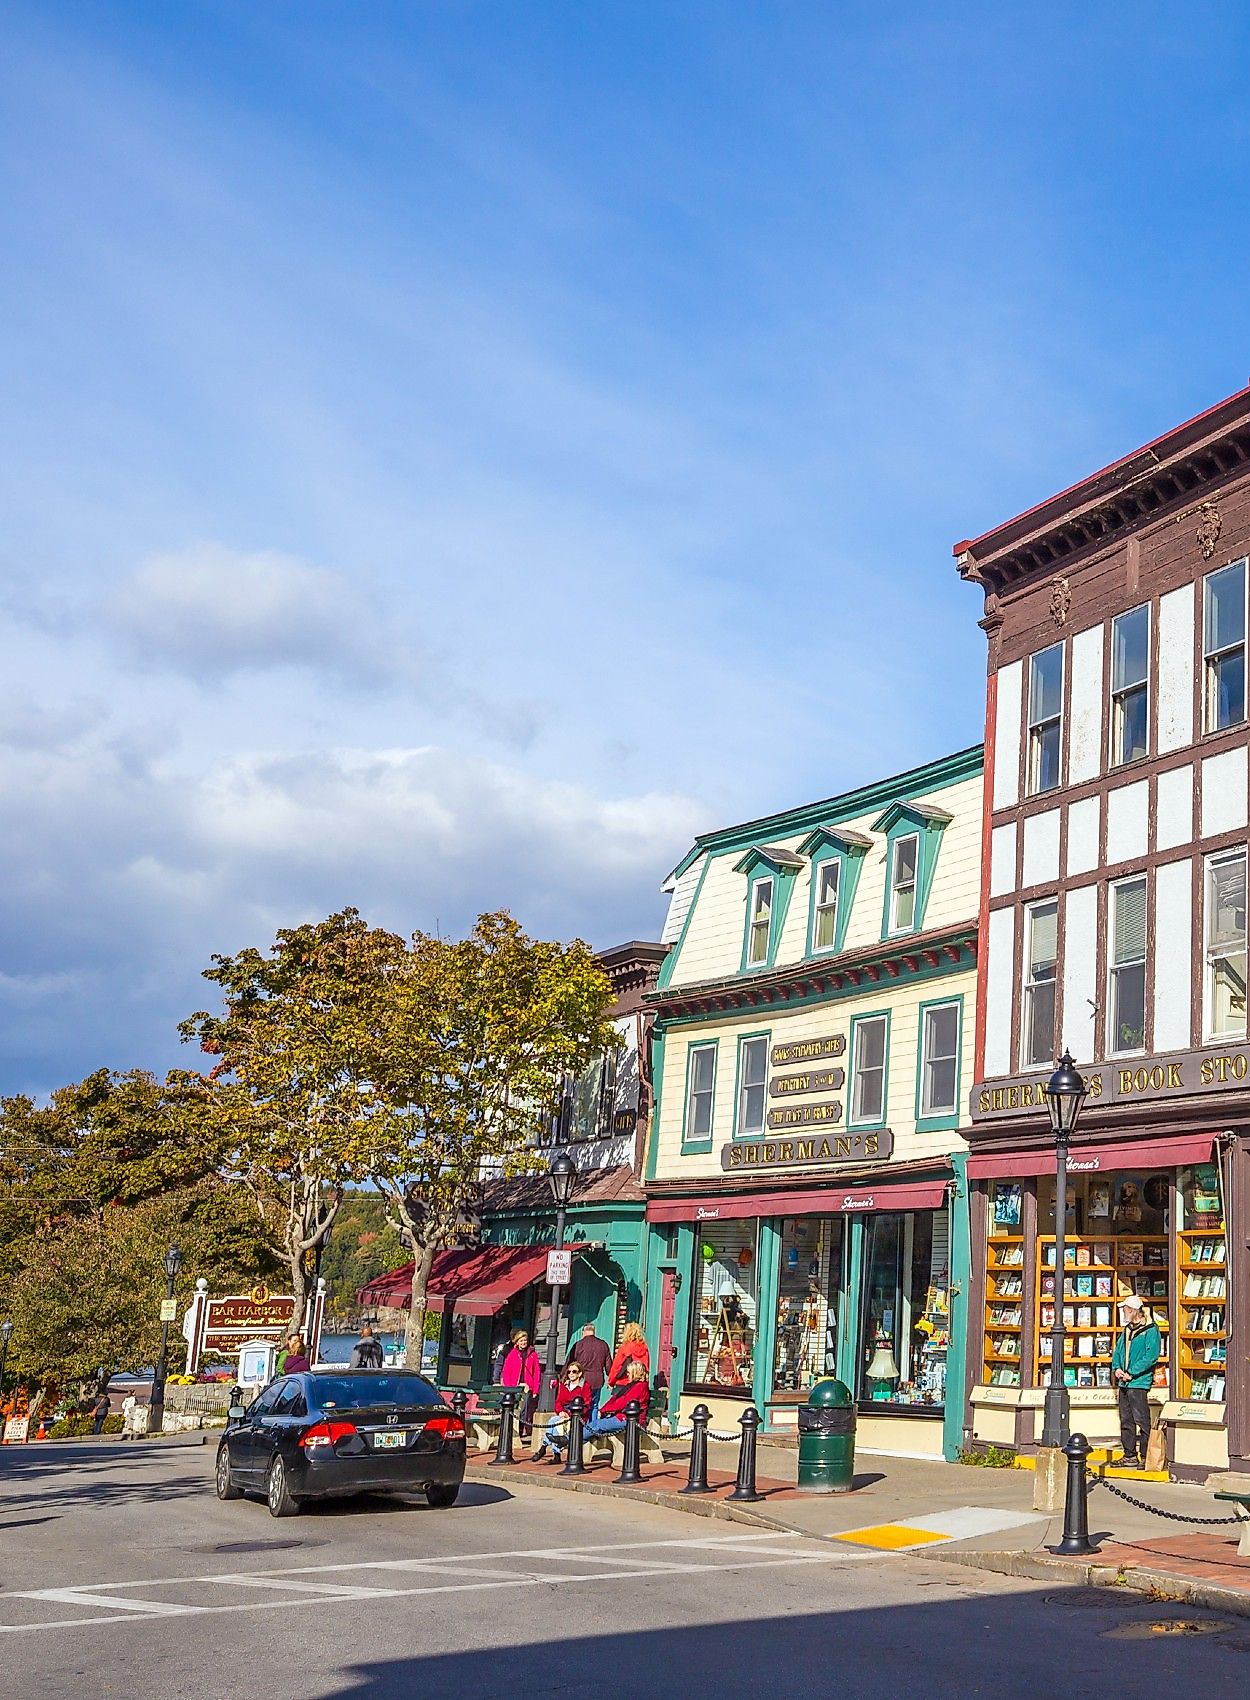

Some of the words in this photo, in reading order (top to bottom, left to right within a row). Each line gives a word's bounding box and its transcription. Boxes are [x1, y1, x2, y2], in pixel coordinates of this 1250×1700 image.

[979, 1073, 1103, 1114] SHERM'S
[1118, 1063, 1184, 1094] BOOK
[730, 1133, 879, 1166] SHERMAN'S
[212, 1305, 235, 1317] BAR
[238, 1305, 282, 1317] HARBOR
